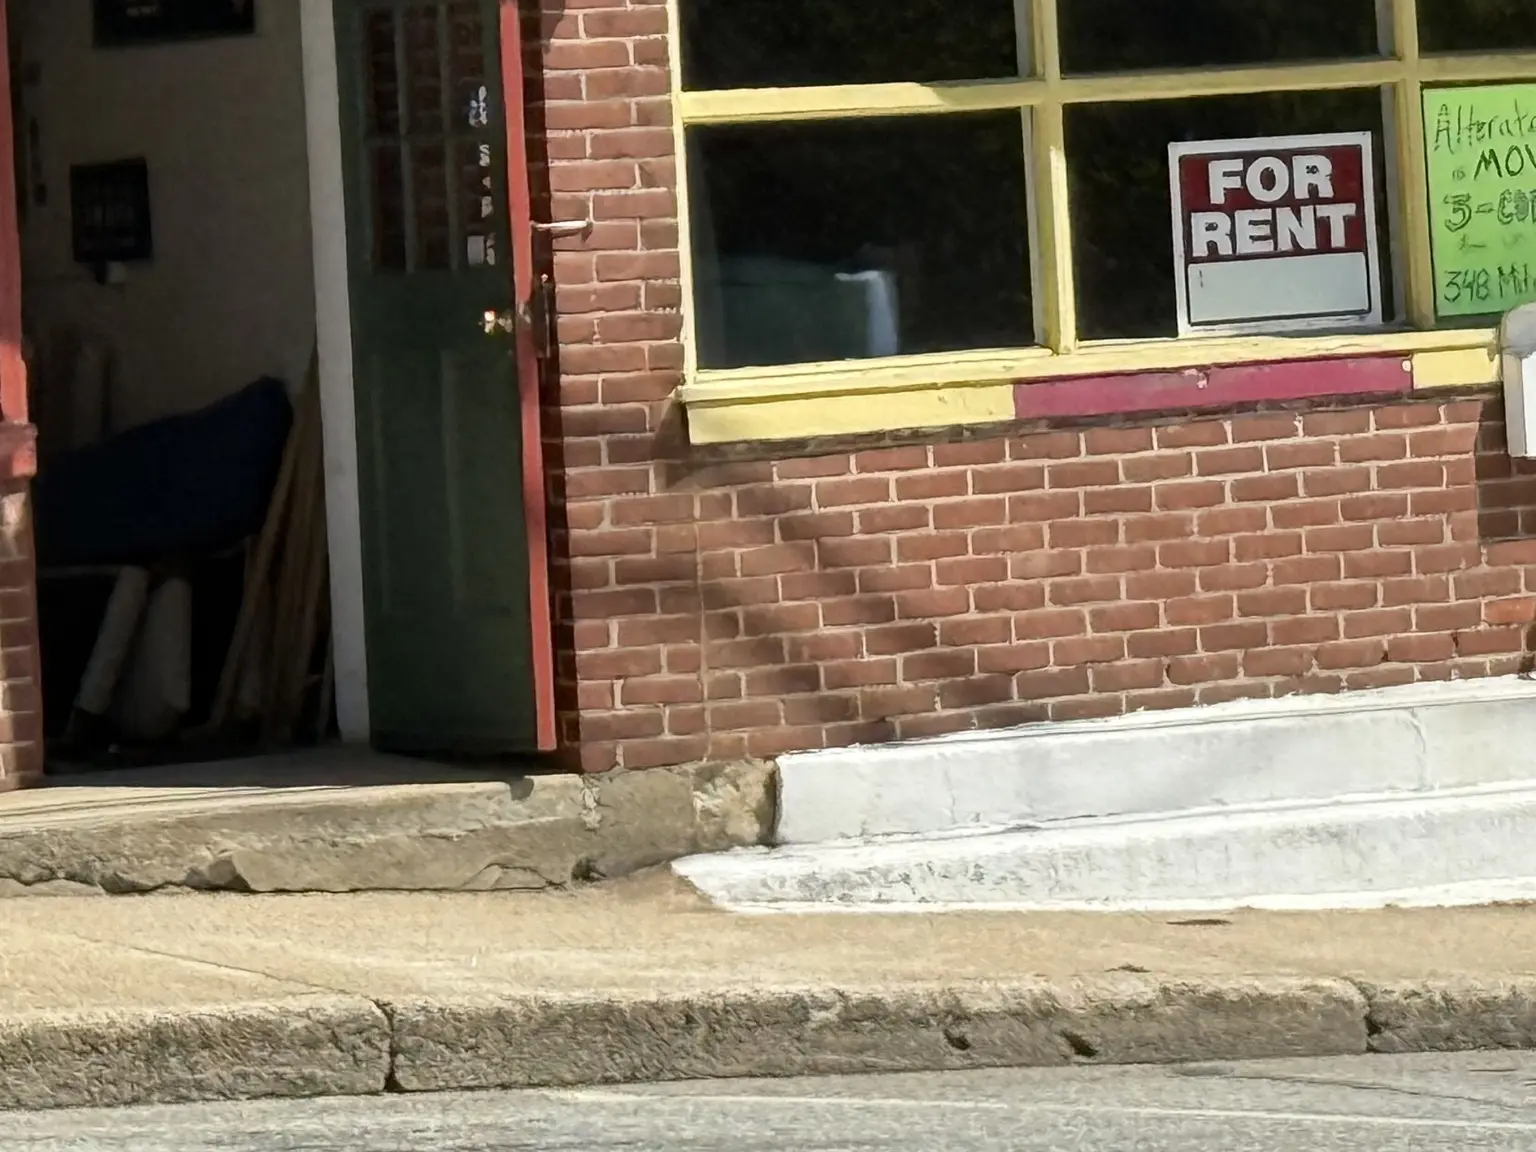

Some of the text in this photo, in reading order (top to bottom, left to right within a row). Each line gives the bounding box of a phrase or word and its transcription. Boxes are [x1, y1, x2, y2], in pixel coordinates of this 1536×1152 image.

[1207, 154, 1334, 205] FOR
[1190, 201, 1356, 258] RENT
[1444, 269, 1490, 303] 348
